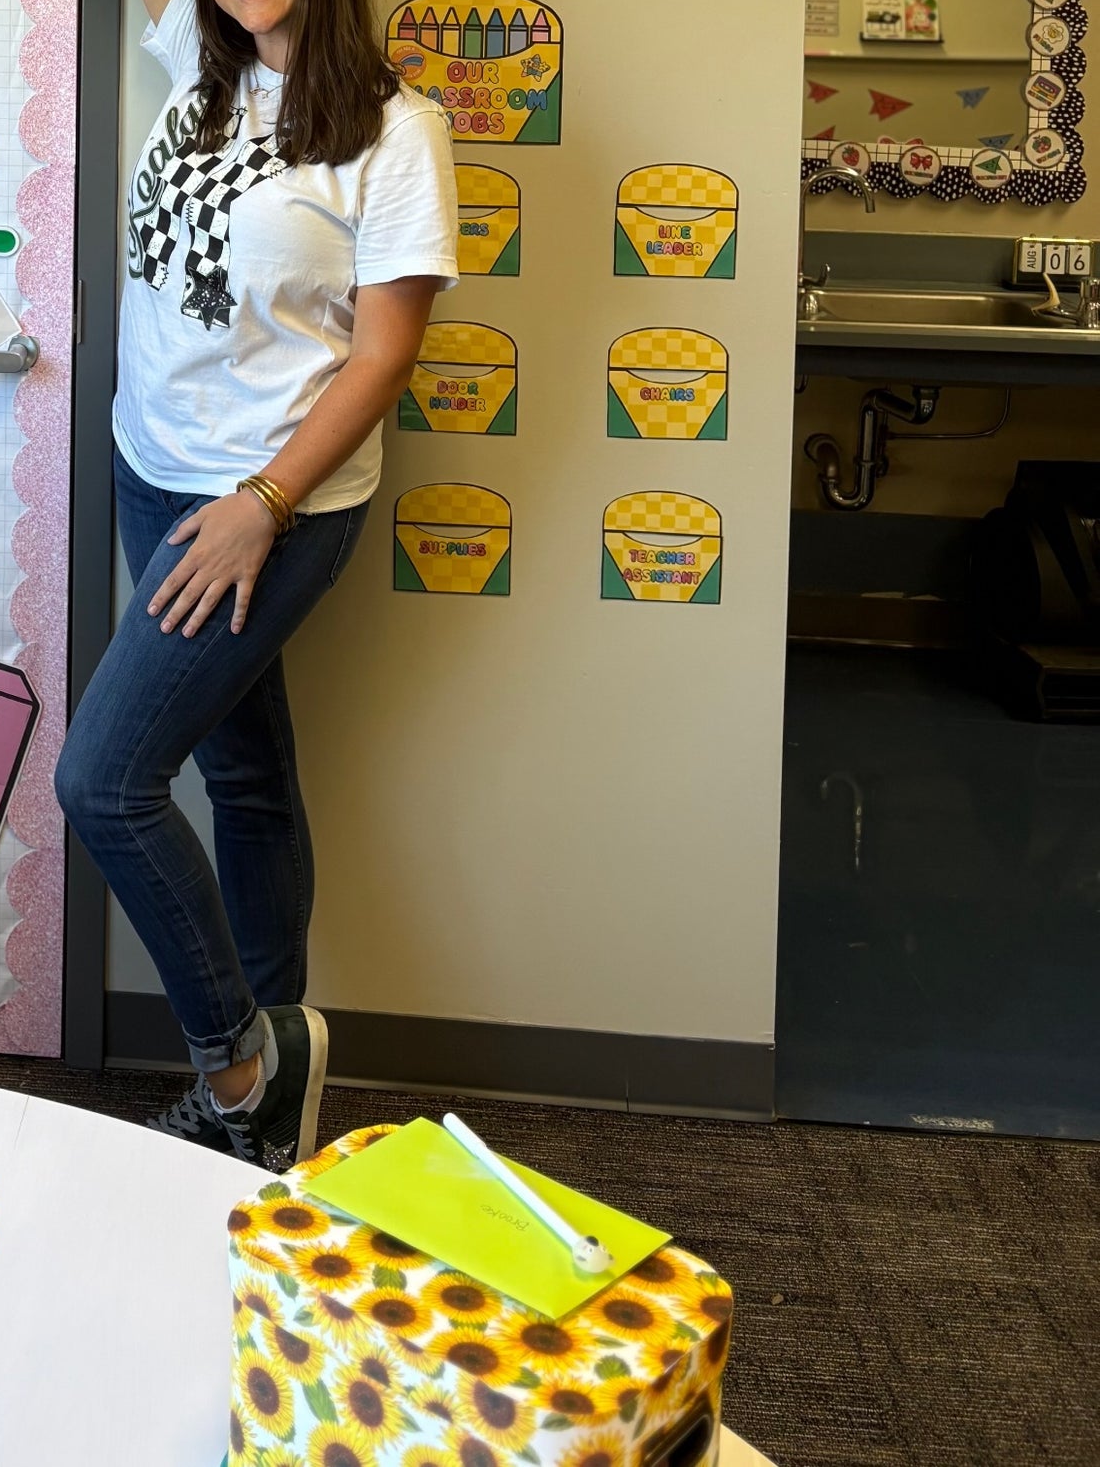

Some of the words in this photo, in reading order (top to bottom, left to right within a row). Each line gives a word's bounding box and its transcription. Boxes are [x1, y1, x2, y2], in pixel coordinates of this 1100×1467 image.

[447, 61, 499, 84] OUR
[416, 86, 548, 111] ASSROOM
[658, 224, 691, 239] LINE
[646, 241, 703, 256] LEADER
[1027, 250, 1037, 269] AUG
[436, 380, 479, 396] DOOR
[640, 387, 695, 401] CHAIRS
[429, 396, 486, 412] HOLDER
[419, 540, 486, 556] SUPPLIES
[629, 549, 696, 565] TEACHER
[623, 568, 702, 585] ASSISTANT
[479, 1205, 530, 1232] Brooke
